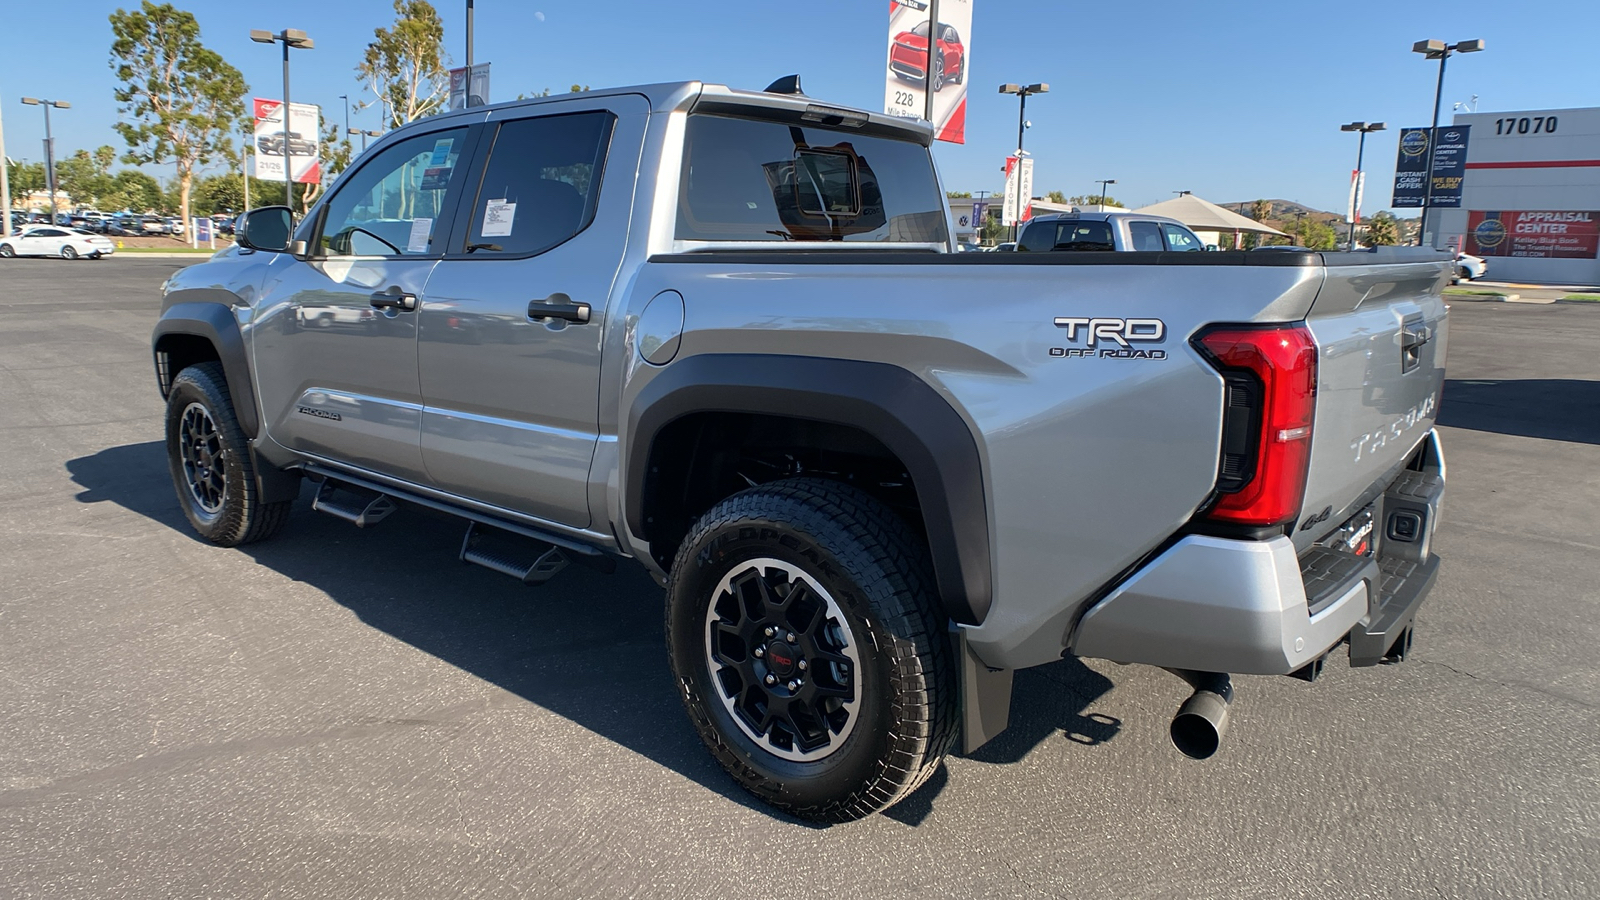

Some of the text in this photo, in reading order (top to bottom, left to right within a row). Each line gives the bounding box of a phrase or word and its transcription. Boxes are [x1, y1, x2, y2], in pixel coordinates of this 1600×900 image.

[895, 91, 914, 107] 228
[1496, 116, 1558, 135] 17070
[259, 161, 281, 170] 21/26
[1517, 212, 1592, 223] APPRAISAL
[1515, 223, 1567, 234] CENTER
[1514, 237, 1538, 245] Kelley
[1053, 317, 1168, 350] TRD
[1049, 347, 1168, 361] OFF ROAD
[298, 406, 342, 421] TACOMA
[1350, 391, 1436, 463] TACOMA
[770, 653, 791, 666] TRD
